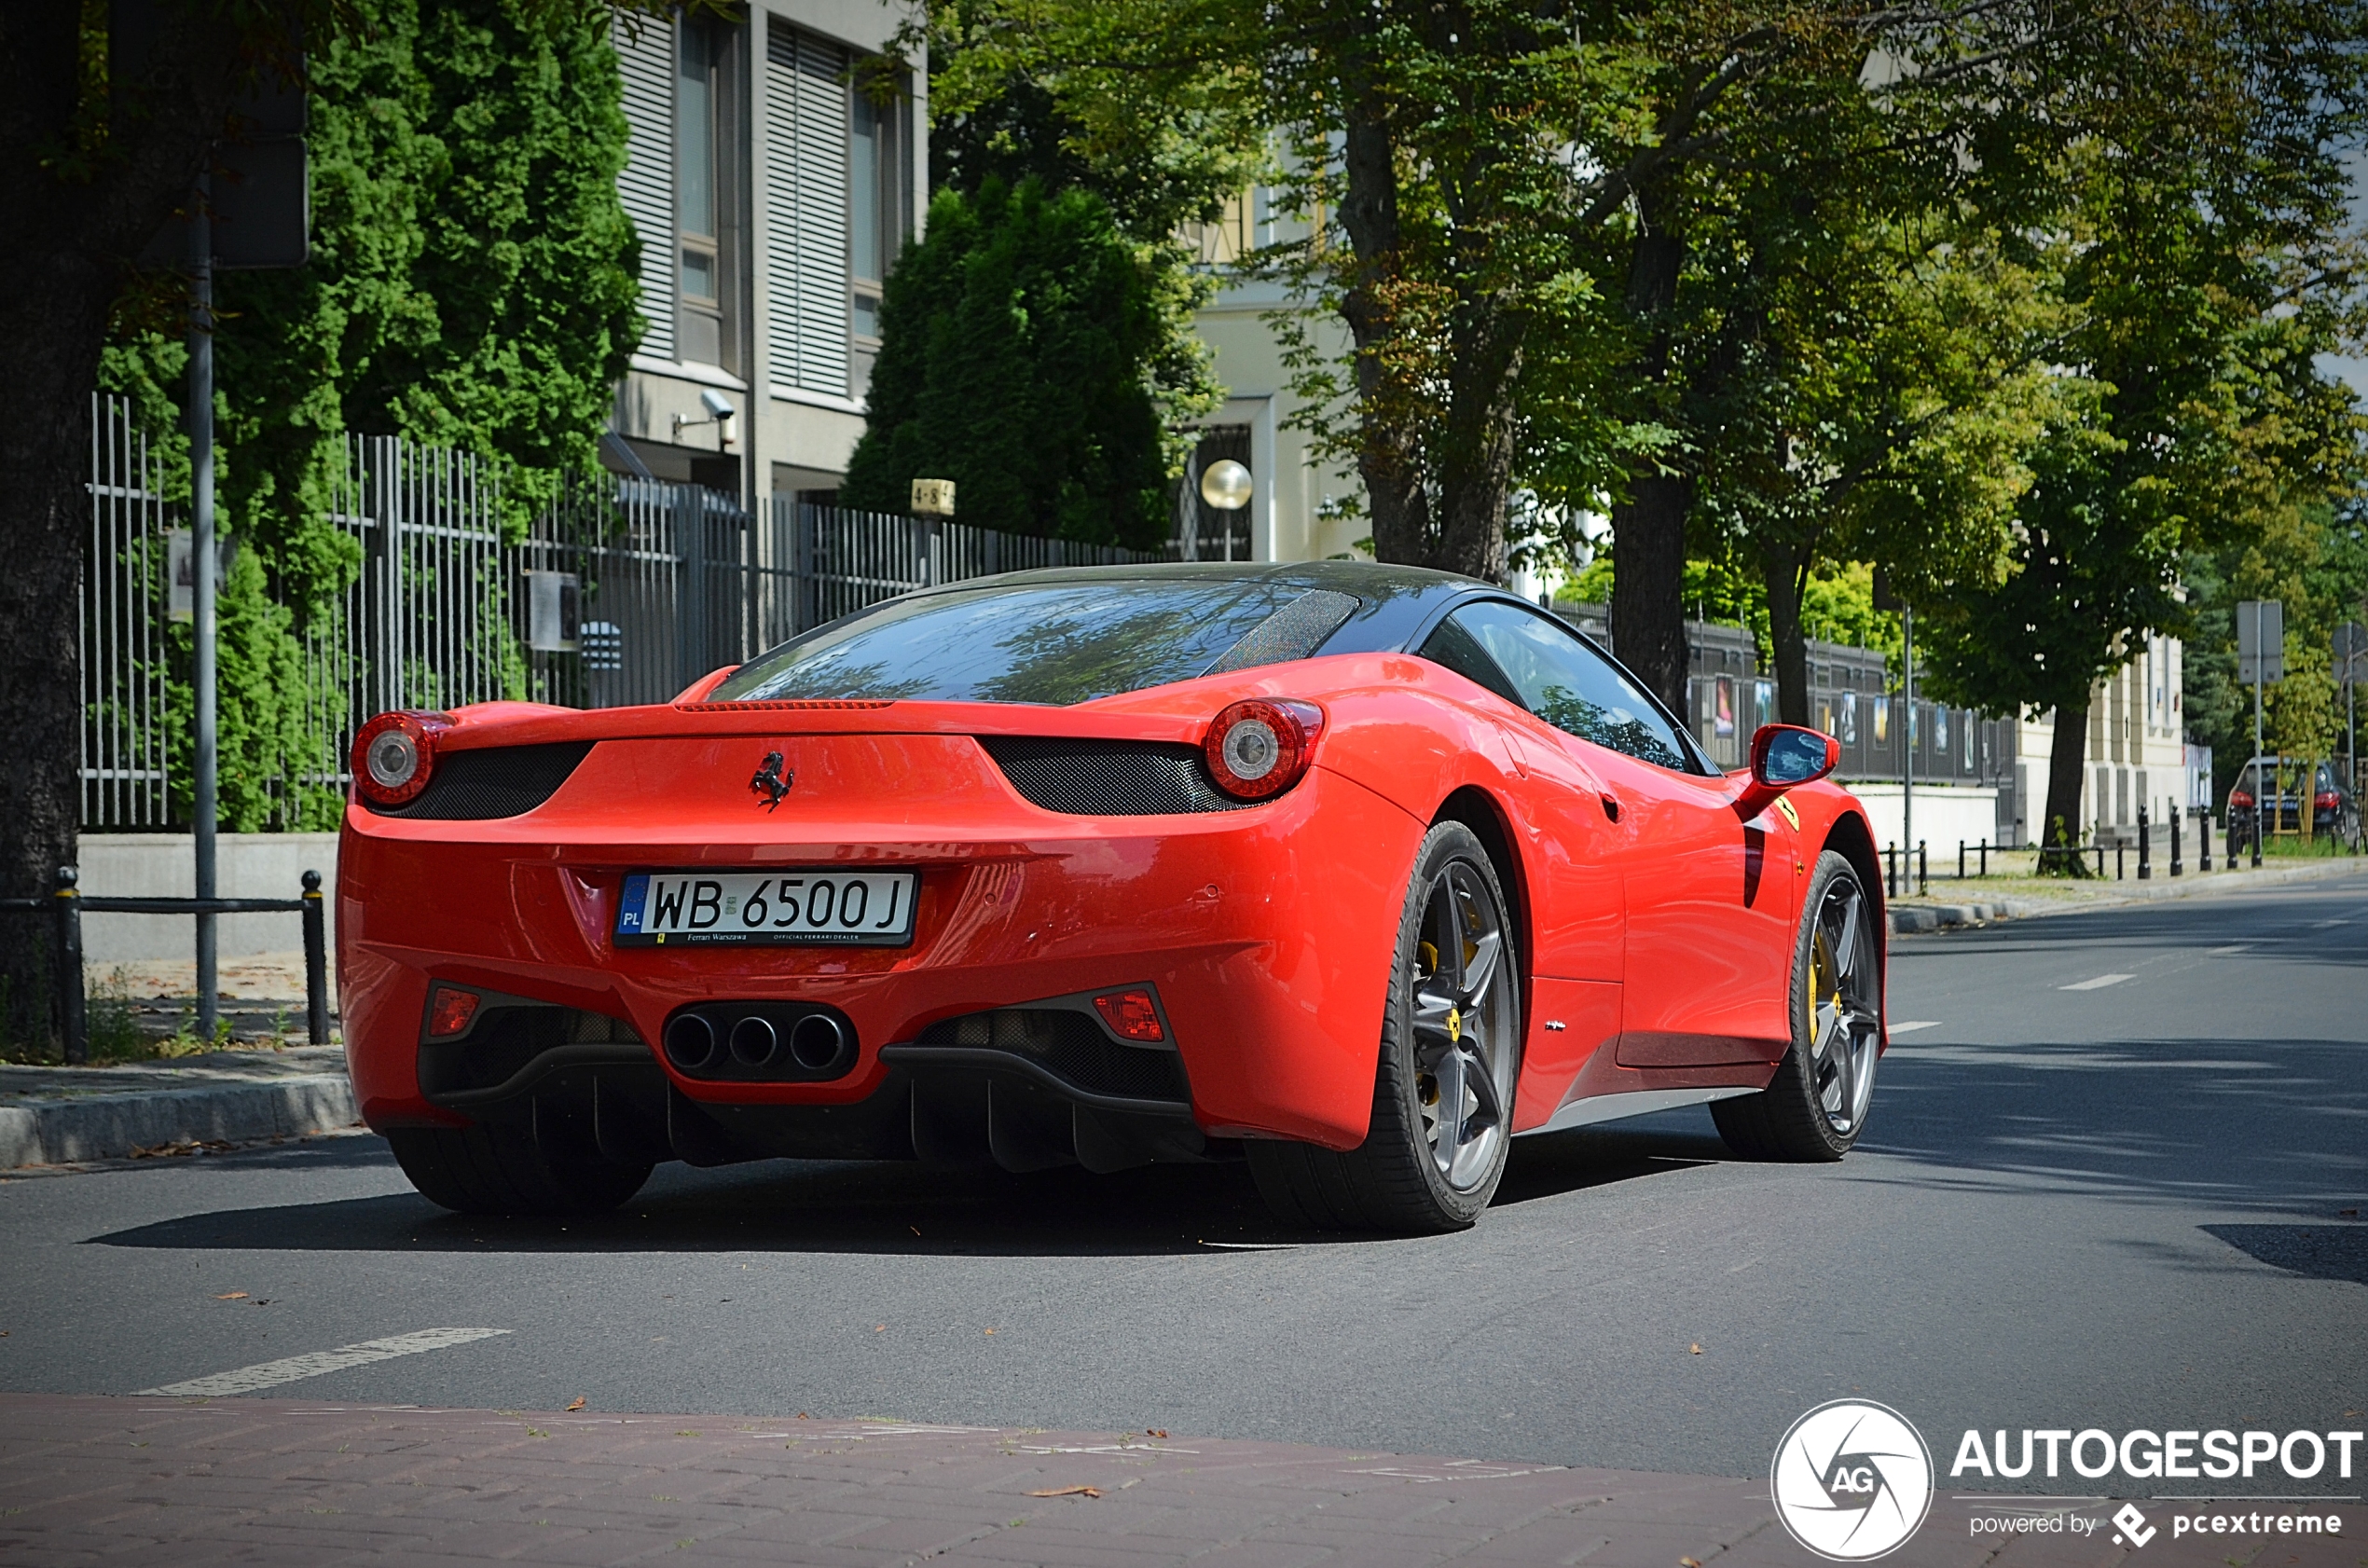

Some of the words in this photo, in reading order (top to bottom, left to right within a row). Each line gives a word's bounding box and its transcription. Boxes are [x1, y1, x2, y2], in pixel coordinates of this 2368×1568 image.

[653, 880, 723, 929] WB
[742, 879, 901, 929] 6500J
[623, 913, 640, 926] PL
[687, 933, 710, 942] Ferrari
